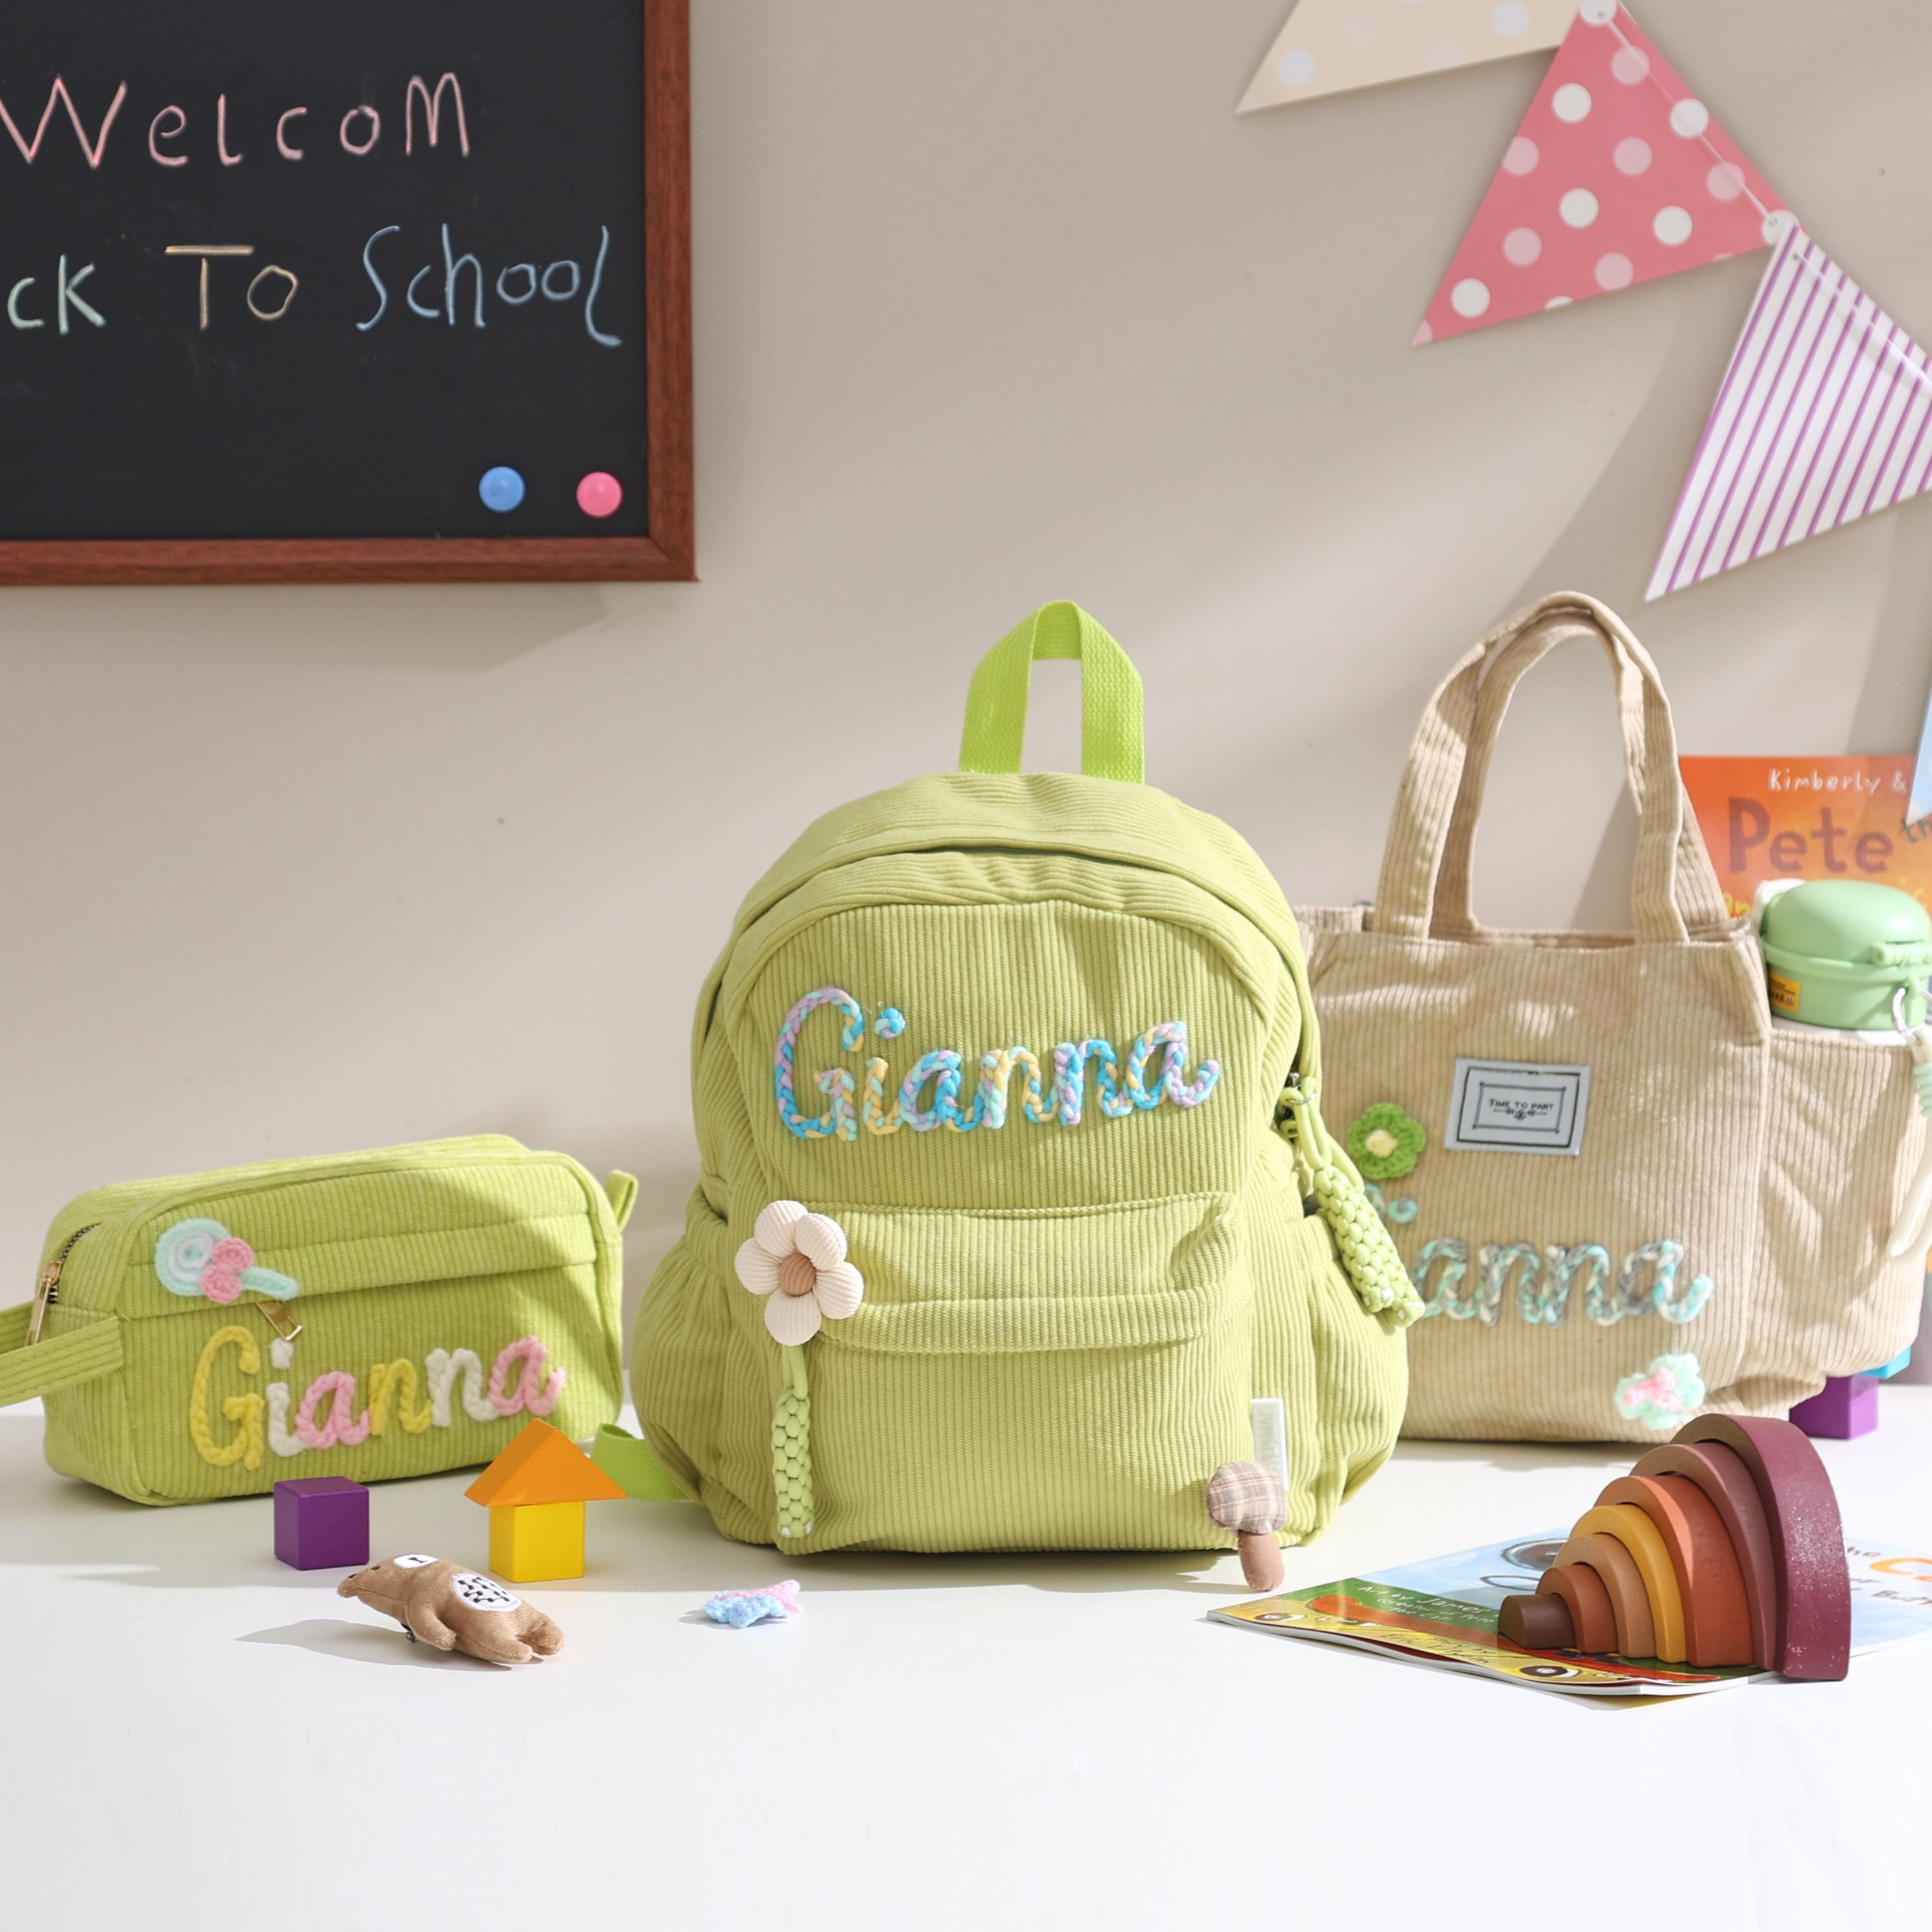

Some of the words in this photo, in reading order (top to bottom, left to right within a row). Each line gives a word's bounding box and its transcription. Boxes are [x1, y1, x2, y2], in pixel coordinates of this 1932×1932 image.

[356, 223, 621, 346] School
[1768, 768, 1880, 793] Kimberly
[1893, 770, 1907, 791] &
[1728, 796, 1895, 874] Pete
[775, 987, 1220, 1142] Gianna
[1489, 1099, 1511, 1107] TIME
[1367, 1182, 1714, 1326] anna
[191, 1325, 565, 1470] Gianna
[1357, 1586, 1389, 1595] Art
[1391, 1592, 1414, 1600] by
[1416, 1597, 1491, 1614] James
